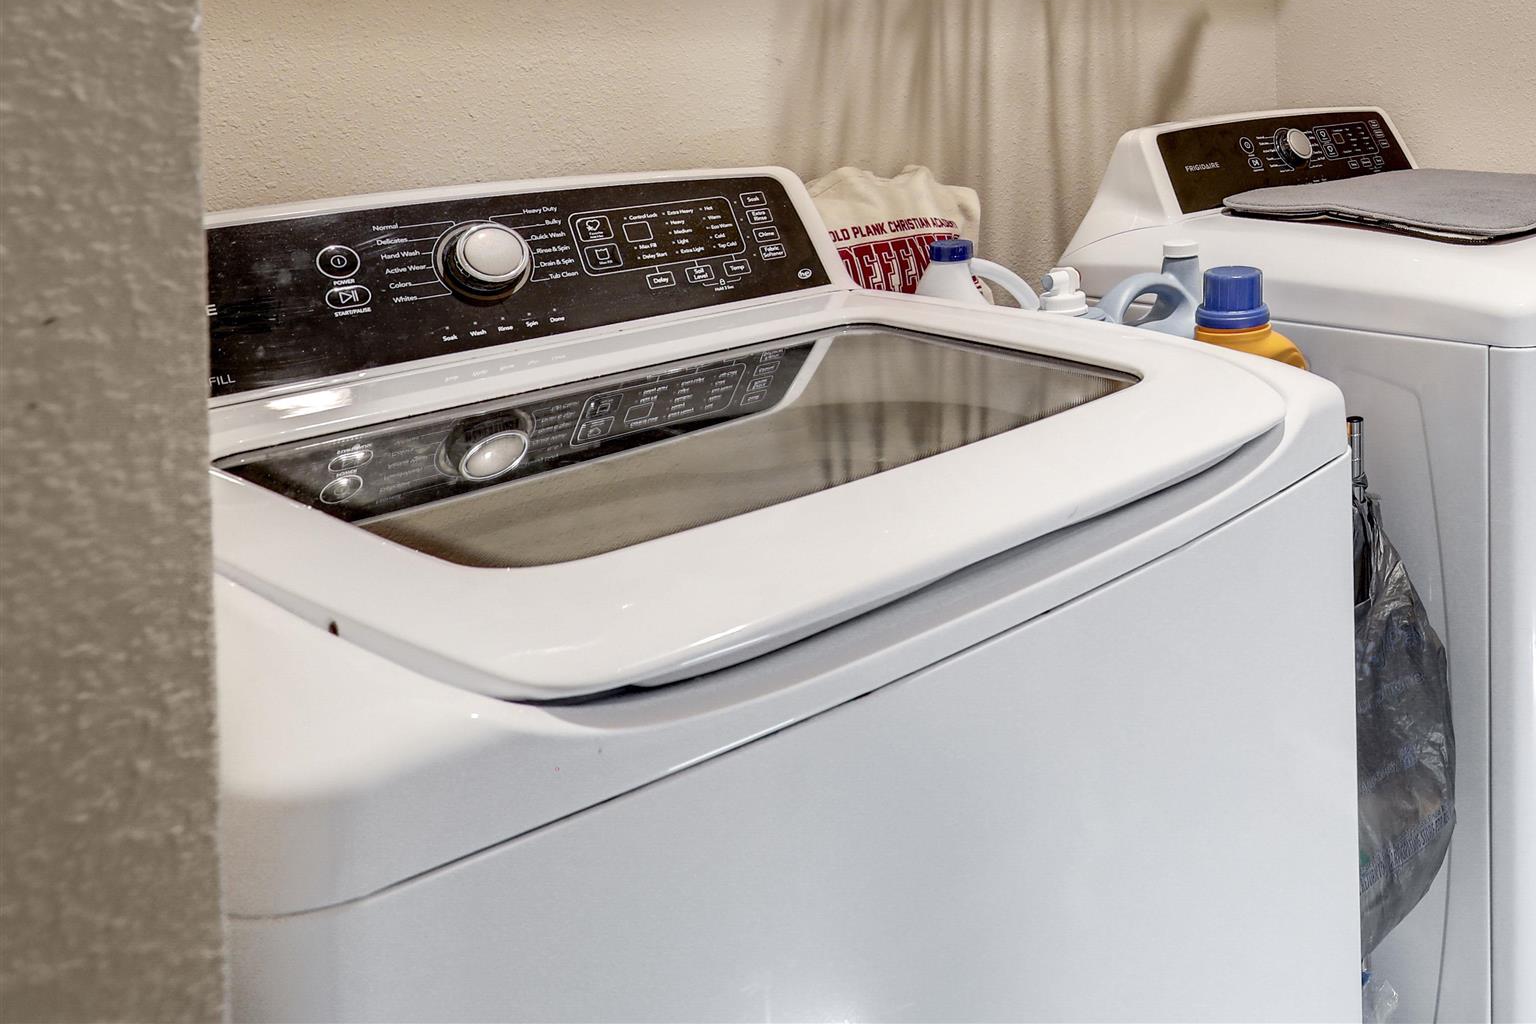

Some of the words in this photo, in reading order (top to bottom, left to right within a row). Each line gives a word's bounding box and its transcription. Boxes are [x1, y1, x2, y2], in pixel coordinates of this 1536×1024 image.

[1185, 162, 1220, 172] FRIGIDAIRE
[372, 223, 398, 232] Normal
[853, 222, 888, 238] PLANK
[888, 217, 930, 233] CHRISTIAN
[376, 237, 408, 246] Delicates
[380, 251, 400, 260] Hand
[385, 266, 407, 275] Active
[407, 264, 426, 272] Wear
[561, 270, 579, 278] Clean
[333, 278, 355, 286] POWER
[389, 281, 412, 289] Colors
[392, 295, 418, 304] Whites
[334, 307, 372, 317] START/PAUSE
[525, 320, 539, 328] Spin
[470, 329, 487, 337] Wash
[442, 334, 458, 342] Soak
[209, 374, 236, 386] FILL
